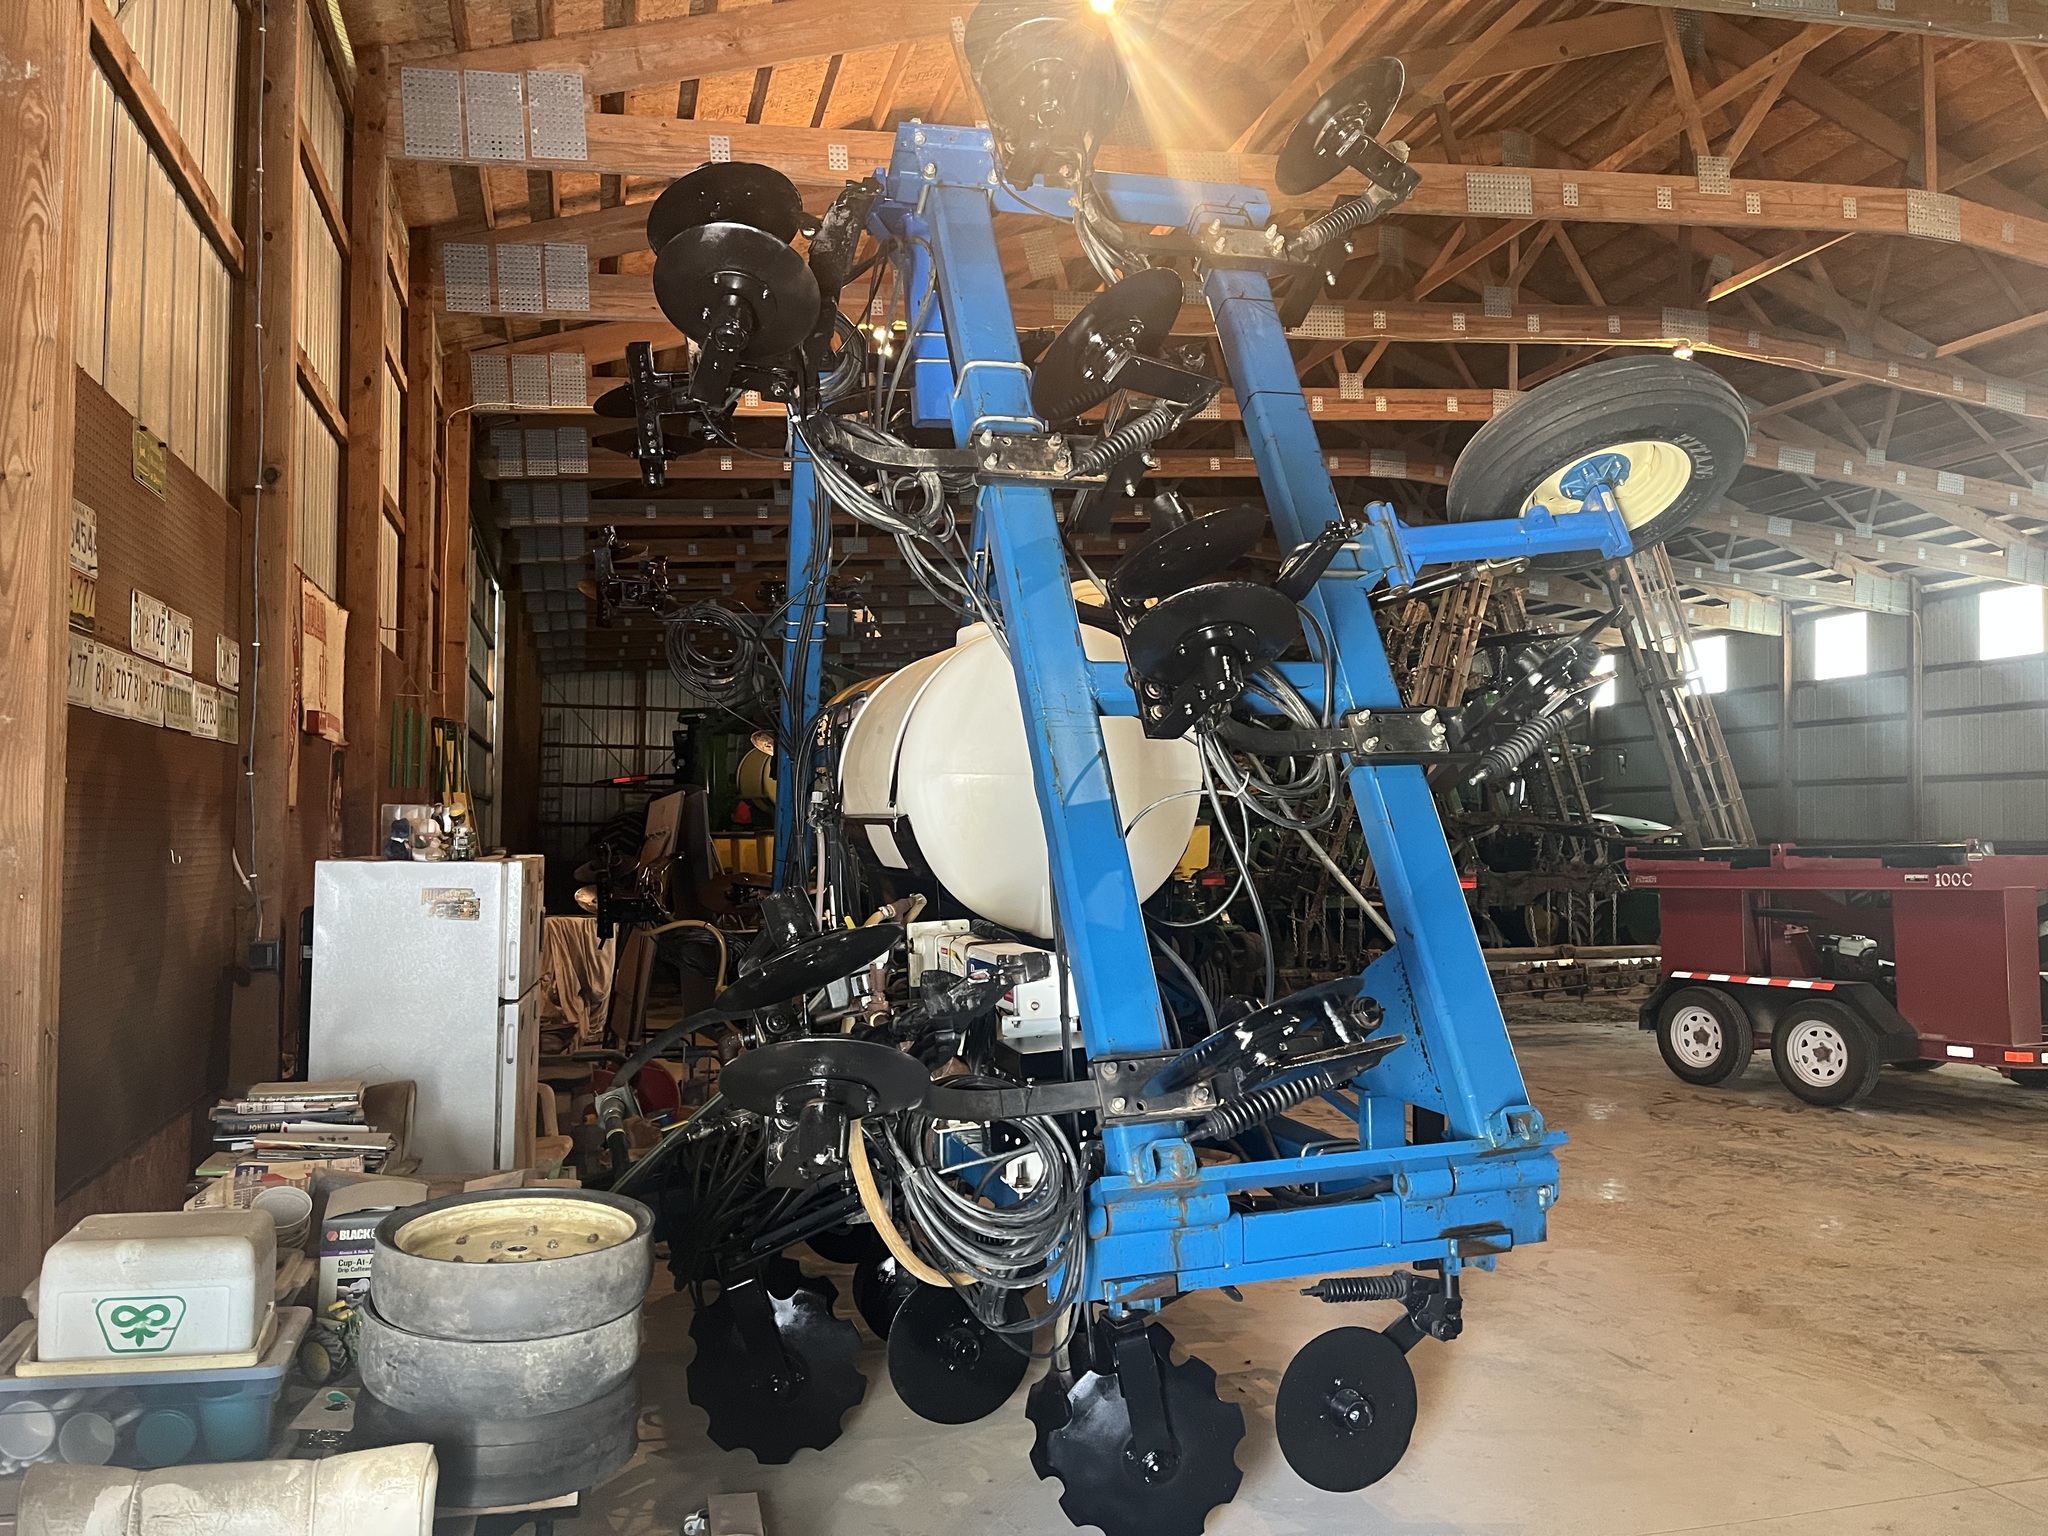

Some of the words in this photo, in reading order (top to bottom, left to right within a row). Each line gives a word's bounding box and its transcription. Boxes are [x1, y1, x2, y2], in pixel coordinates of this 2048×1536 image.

[1673, 433, 1714, 480] TITAN
[1934, 872, 1973, 887] 100C
[248, 1124, 268, 1132] JOHN
